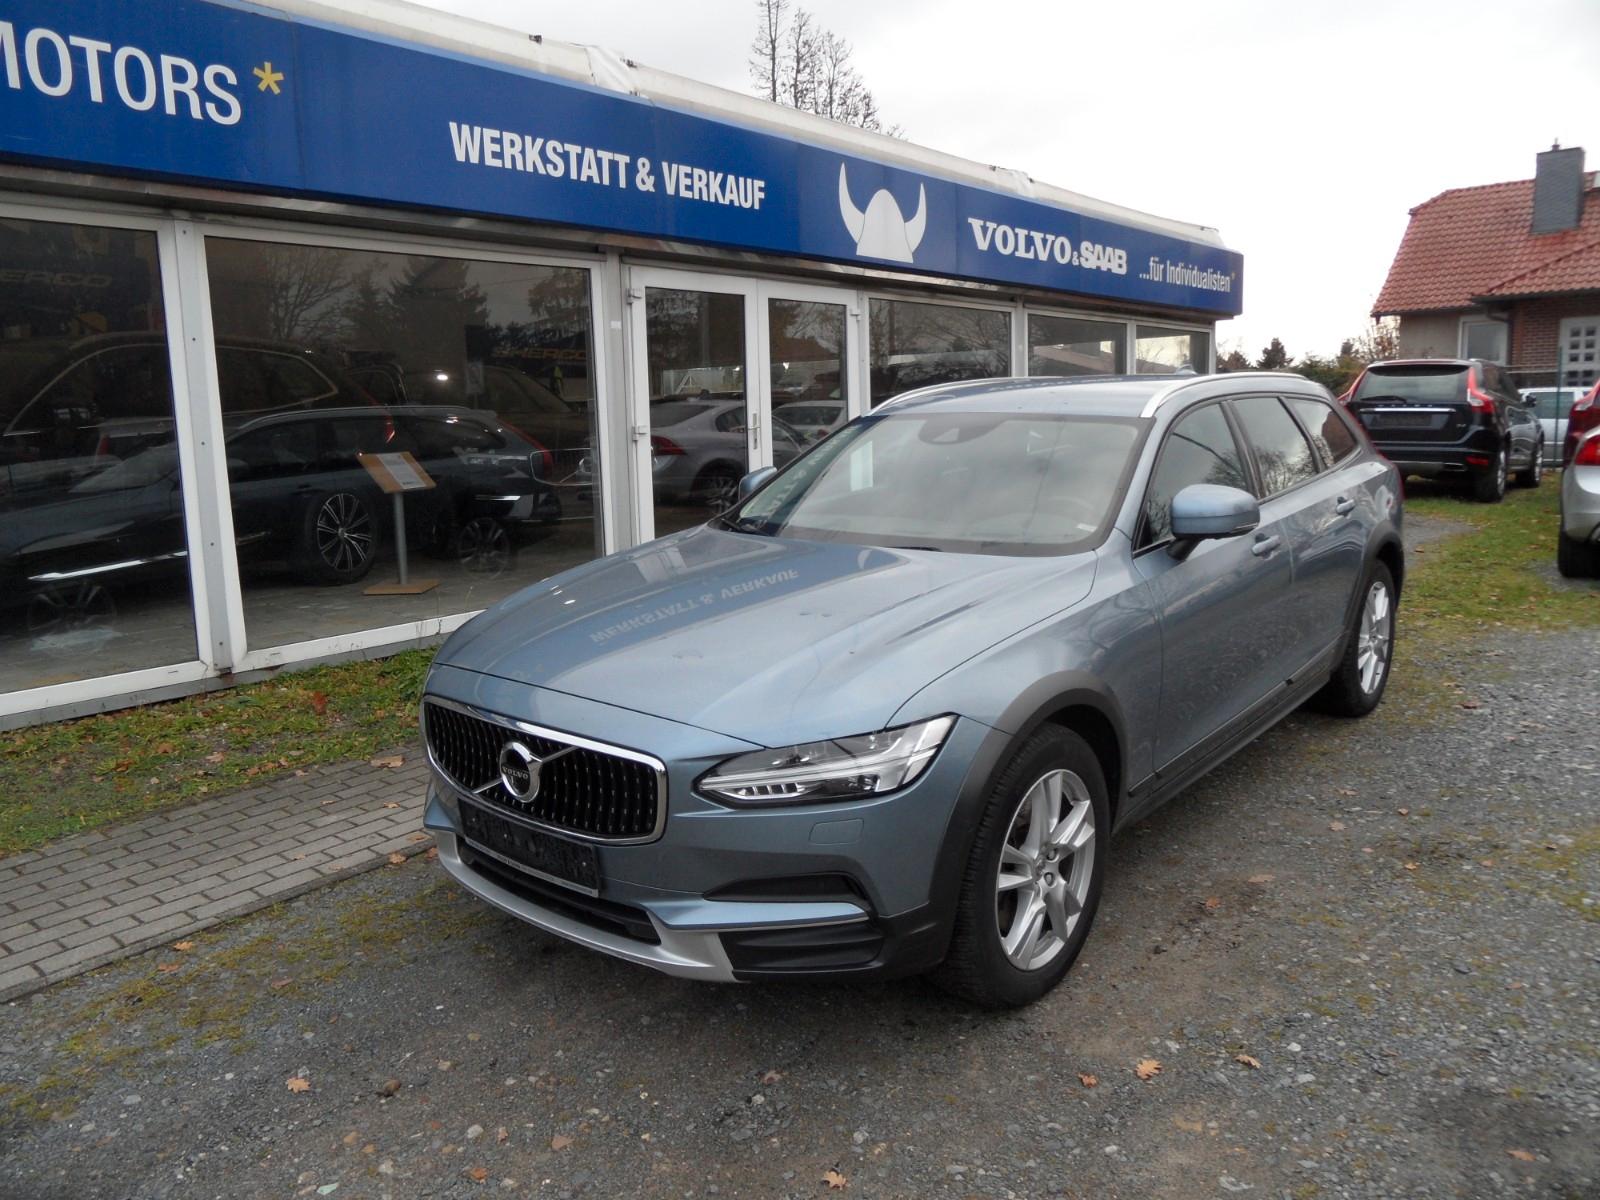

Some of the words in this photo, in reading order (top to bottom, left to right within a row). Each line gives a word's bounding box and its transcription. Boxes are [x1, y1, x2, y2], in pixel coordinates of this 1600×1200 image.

[449, 122, 630, 189] WERKSTATT
[635, 157, 656, 193] &
[661, 161, 766, 210] VERKAUF
[1166, 260, 1231, 293] Individualisten
[501, 765, 529, 780] VOLVO
